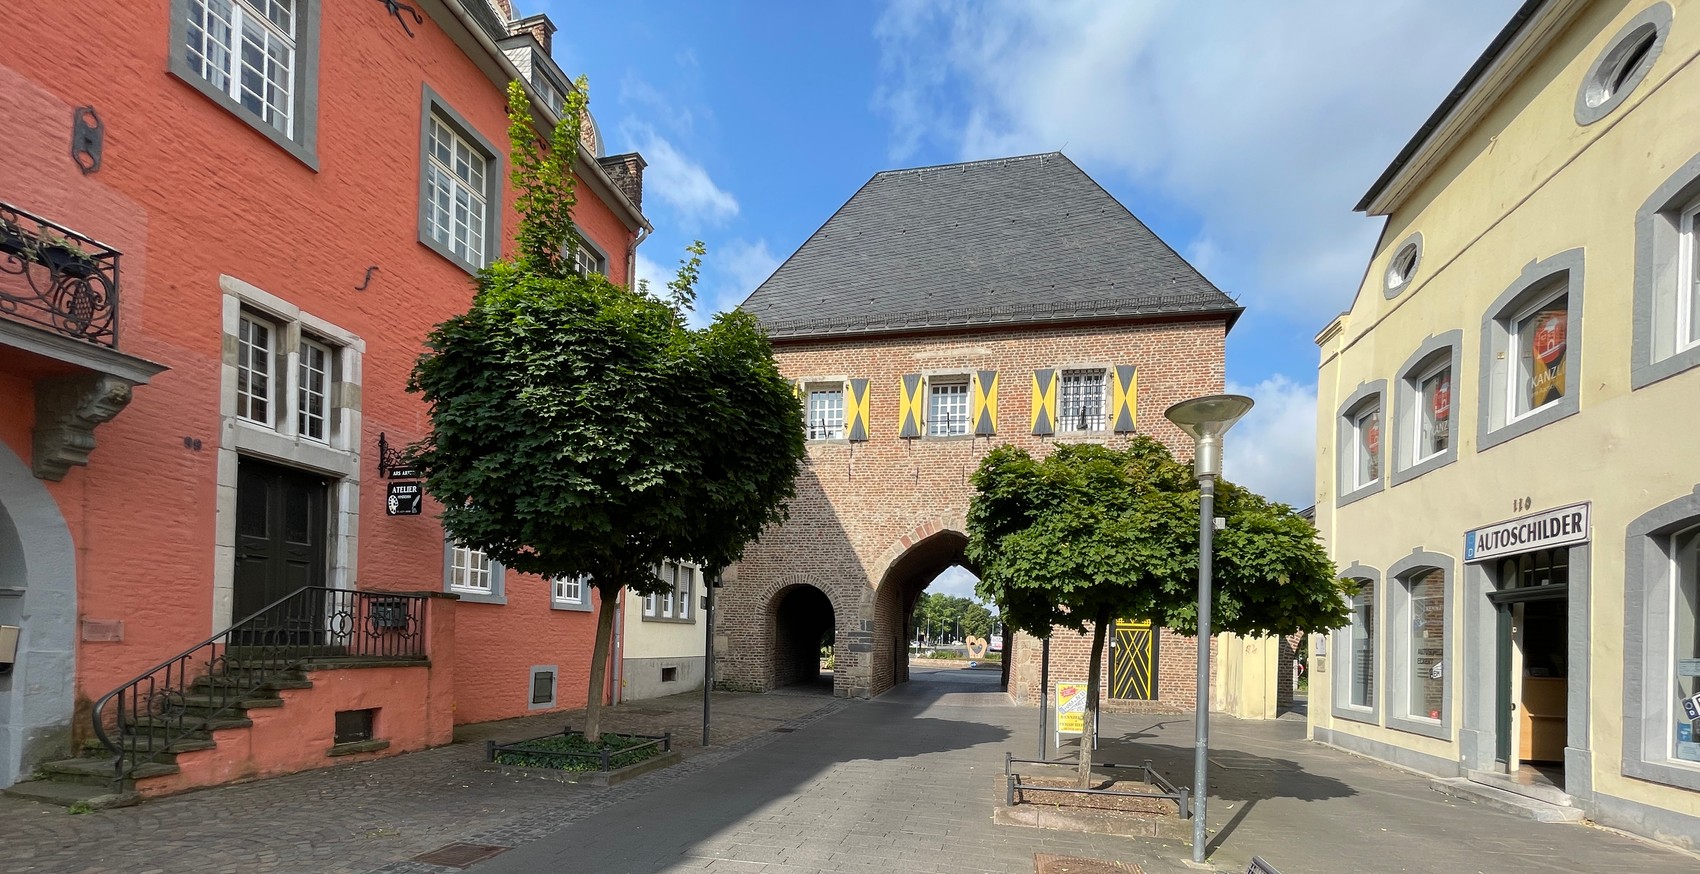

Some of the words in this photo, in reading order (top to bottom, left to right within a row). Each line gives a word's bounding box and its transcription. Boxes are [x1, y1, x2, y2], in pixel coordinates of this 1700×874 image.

[392, 485, 417, 493] ATELIER
[1513, 496, 1532, 512] 110
[1477, 512, 1583, 552] AUTOSCHILDER
[1468, 548, 1474, 557] D
